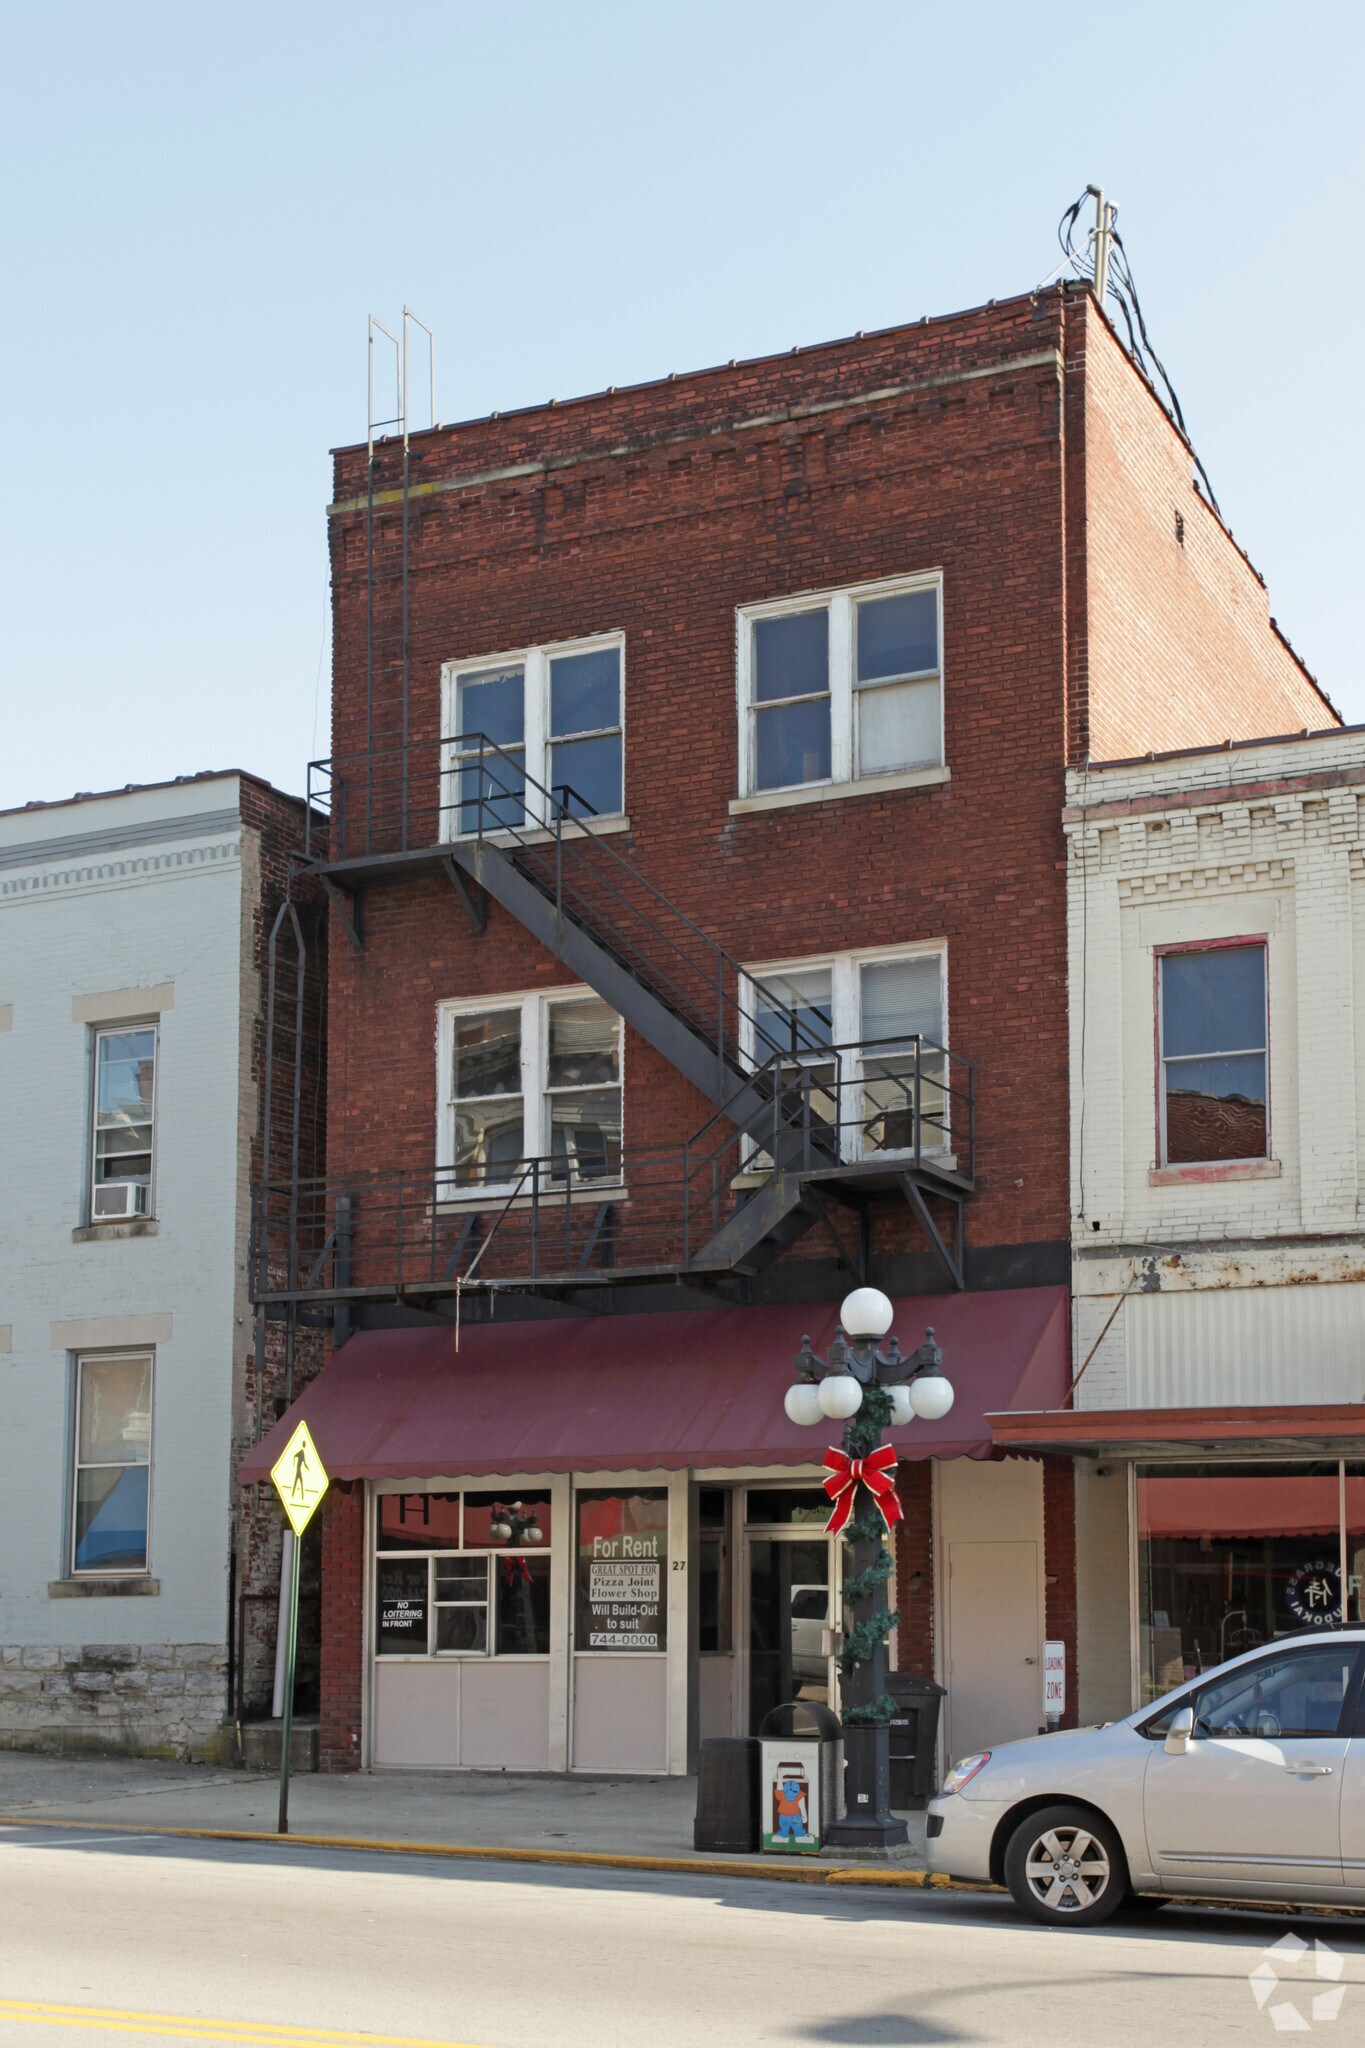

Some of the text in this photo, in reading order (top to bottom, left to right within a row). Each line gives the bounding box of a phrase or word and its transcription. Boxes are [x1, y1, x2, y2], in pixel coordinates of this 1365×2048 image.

[593, 1535, 659, 1558] For Rent
[591, 1564, 657, 1575] GREAT SPOT FOR
[672, 1561, 686, 1571] 27
[593, 1577, 654, 1587] Pizza Joint
[591, 1588, 658, 1601] Flower Shop
[396, 1601, 409, 1610] NO
[591, 1604, 659, 1616] Will Build-Out
[383, 1609, 423, 1618] LOITERING
[382, 1620, 413, 1628] IN FRONT
[606, 1618, 640, 1630] to suit
[591, 1634, 657, 1646] 744-0000
[1045, 1656, 1064, 1670] LOADING
[1046, 1682, 1062, 1699] ZONE
